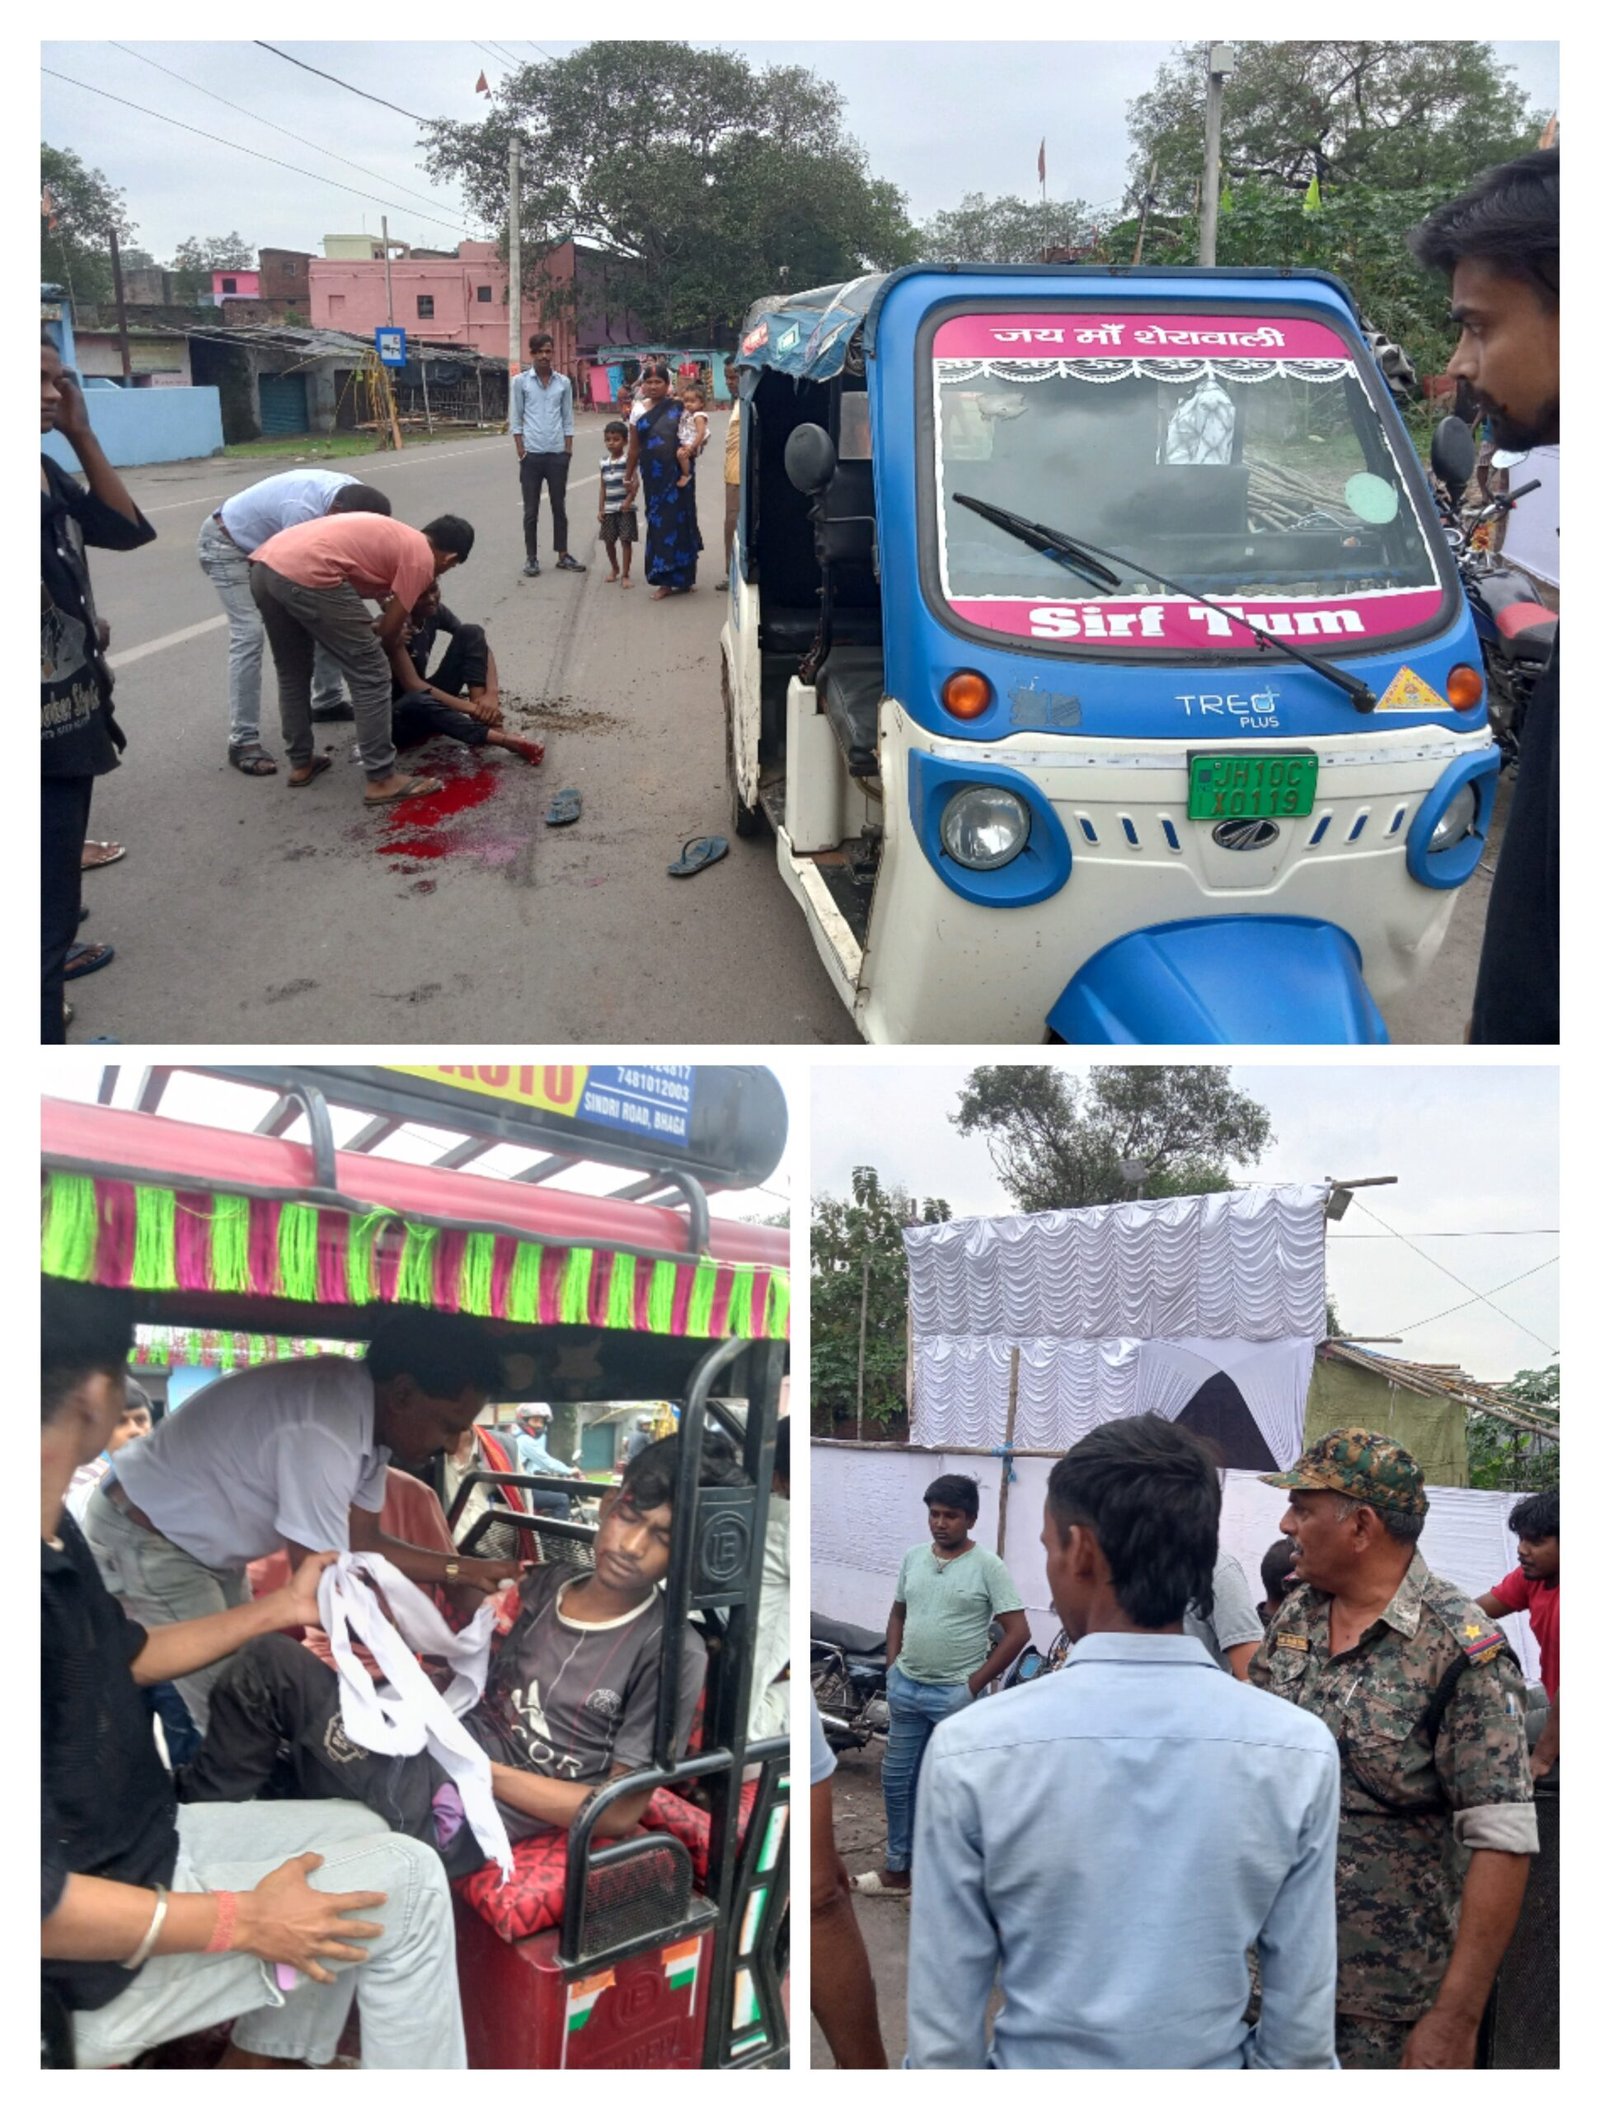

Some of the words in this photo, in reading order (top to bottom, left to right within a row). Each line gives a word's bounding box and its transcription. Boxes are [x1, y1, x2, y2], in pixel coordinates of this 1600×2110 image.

[989, 328, 1065, 344] जय
[1133, 326, 1286, 348] शेरावाली
[1028, 605, 1165, 638] Sirf
[1188, 605, 1366, 637] Tum
[1240, 716, 1280, 729] PLUS
[1214, 760, 1303, 788] JH10C
[617, 1066, 690, 1103] 7481012003
[583, 1091, 621, 1119] SINDRI
[621, 1102, 653, 1130] ROAD,
[653, 1110, 686, 1137] BHAGA
